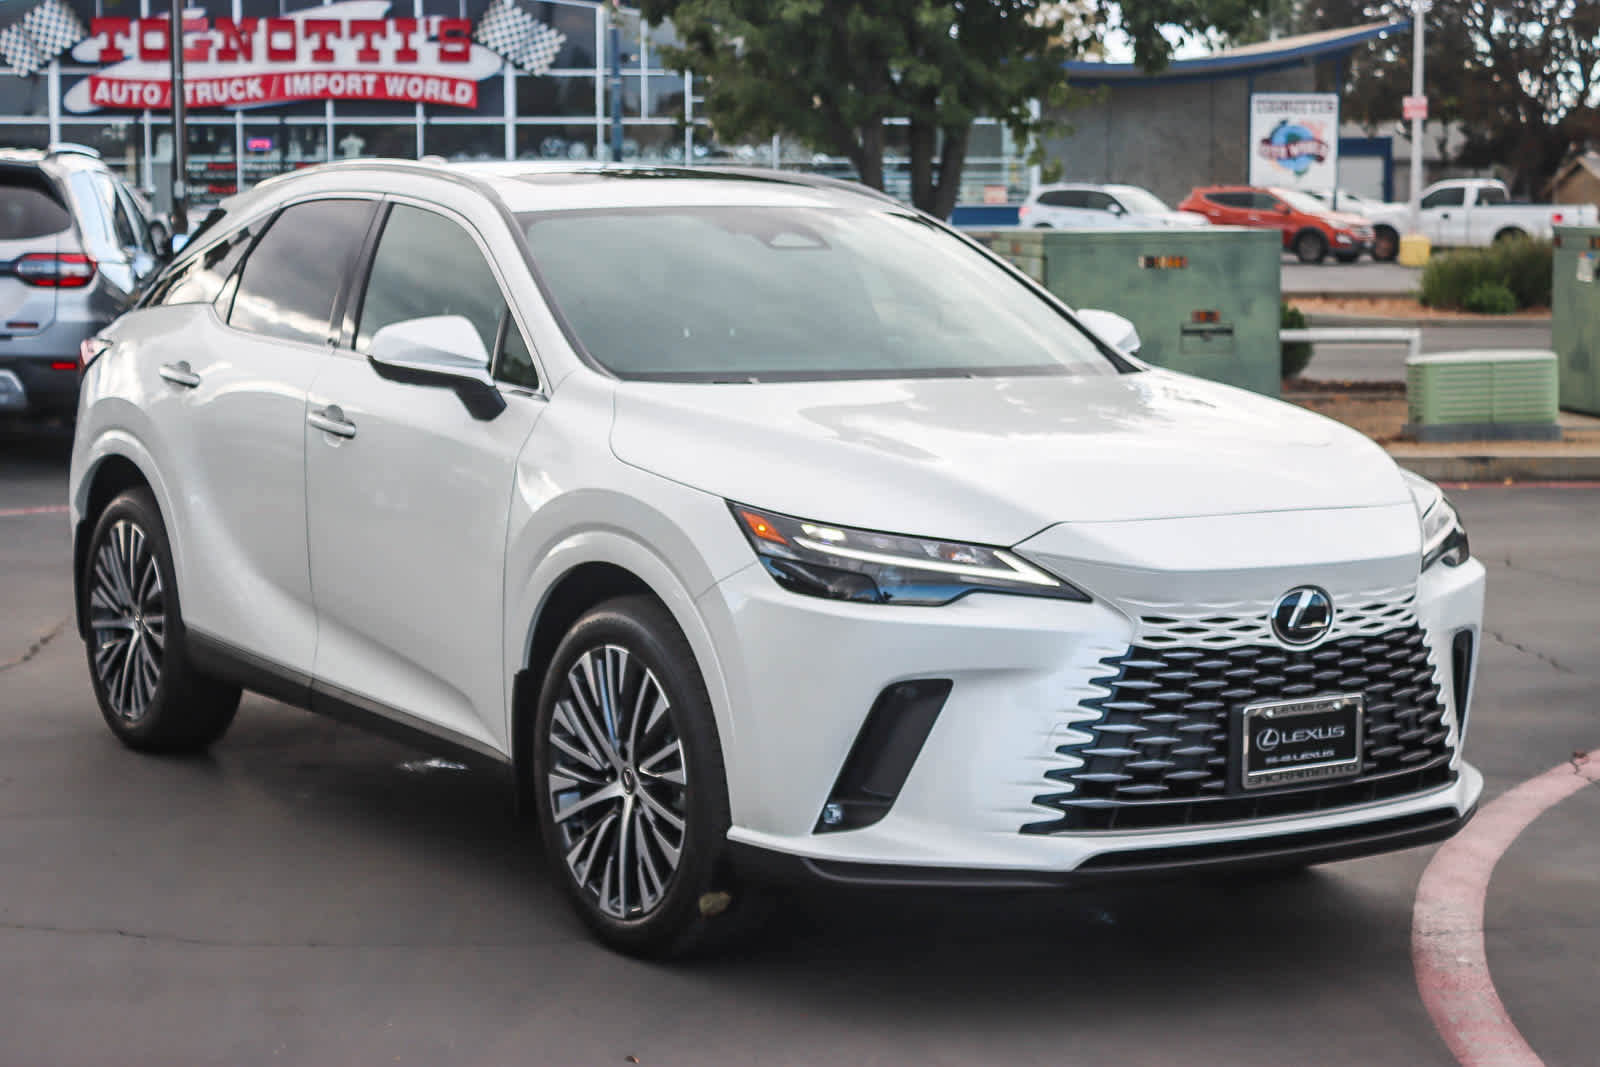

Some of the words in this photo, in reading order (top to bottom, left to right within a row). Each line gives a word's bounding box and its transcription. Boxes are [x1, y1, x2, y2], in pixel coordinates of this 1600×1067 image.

[90, 17, 472, 63] TOGNOTTI'S
[94, 80, 162, 105] AUTO
[183, 76, 264, 104] TRUCK
[284, 73, 377, 97] IMPORT
[385, 75, 473, 105] WORLD
[1281, 727, 1345, 744] LEXUS
